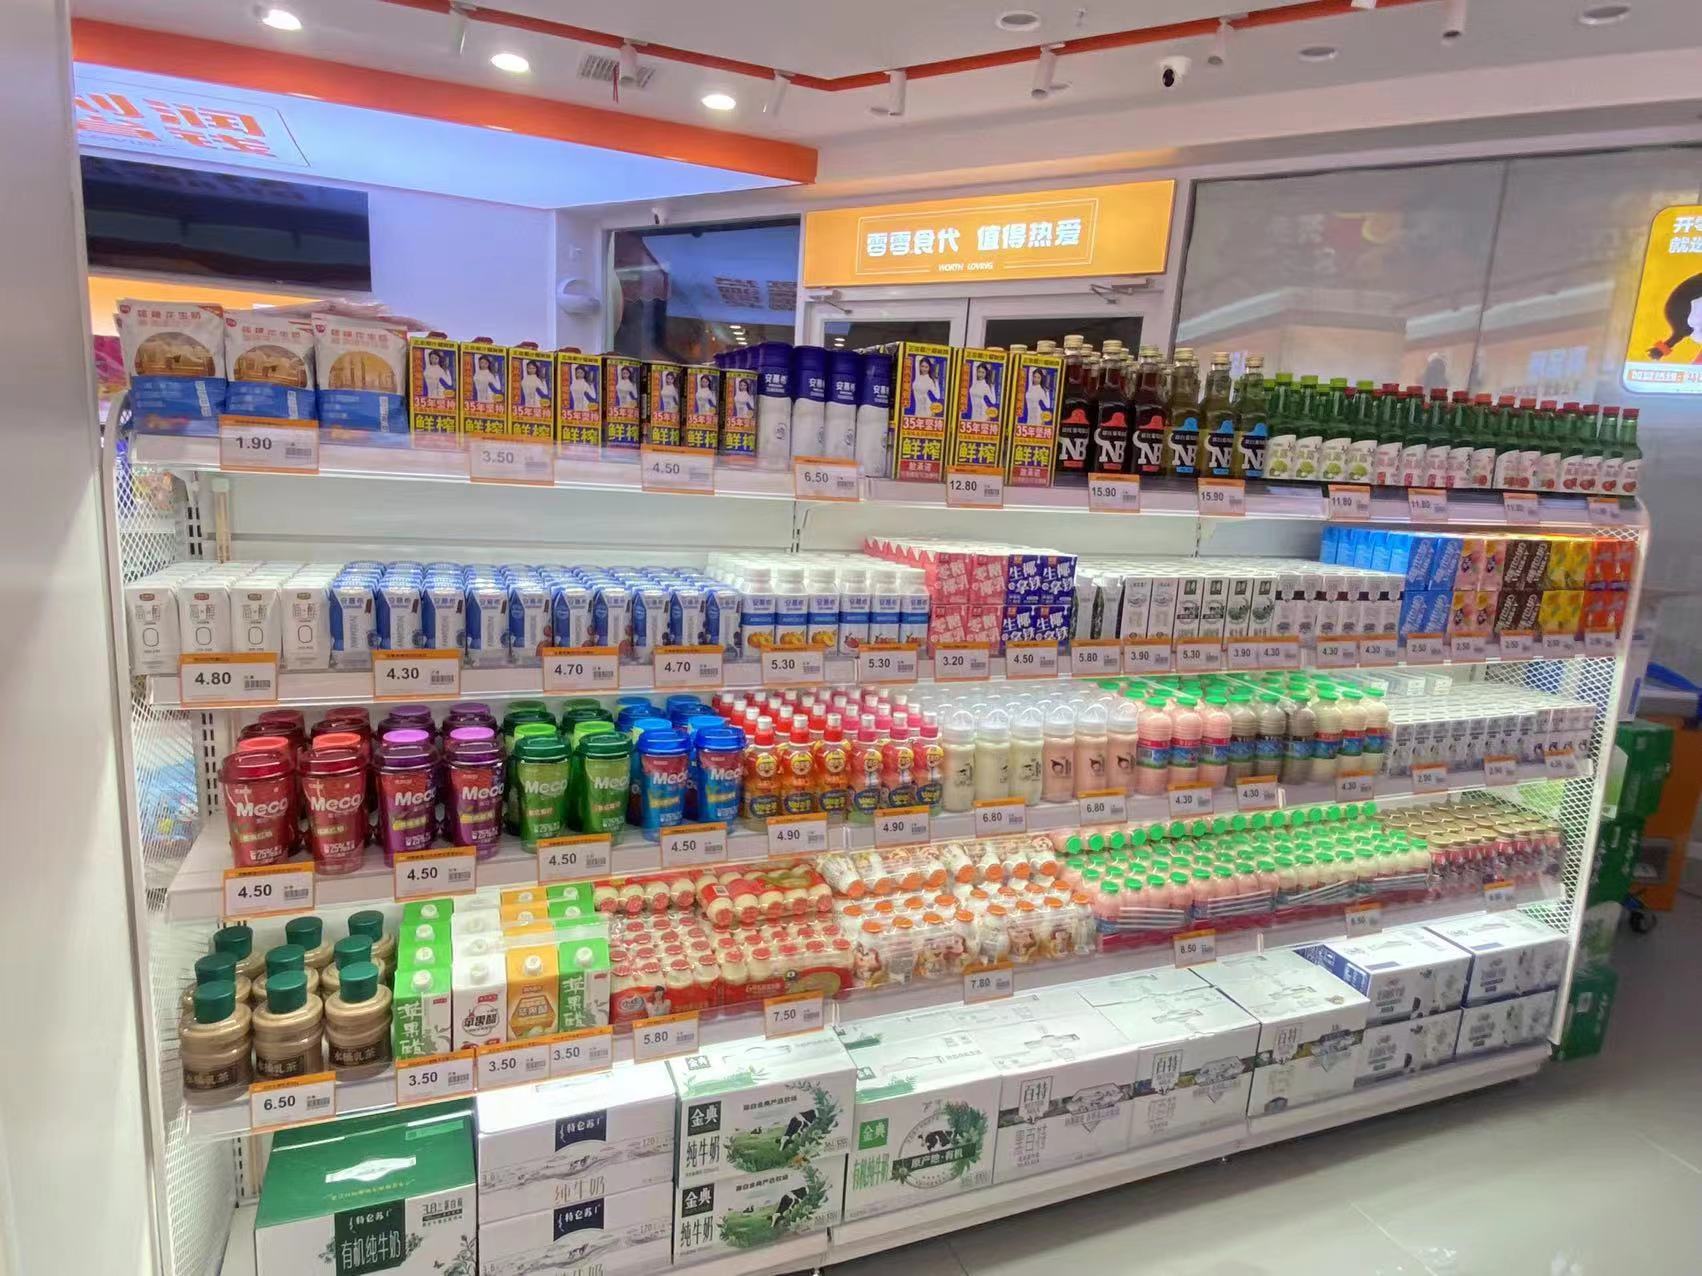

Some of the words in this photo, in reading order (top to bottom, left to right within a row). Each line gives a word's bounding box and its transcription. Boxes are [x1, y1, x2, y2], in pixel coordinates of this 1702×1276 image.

[977, 218, 1081, 251] 值得热爱
[236, 437, 272, 450] 1.90
[902, 439, 941, 460] 鲜榨
[483, 450, 514, 464] 3.50
[959, 442, 996, 463] 鲜榨
[1014, 446, 1050, 466] 鲜榨
[653, 462, 680, 474] 4.50
[805, 472, 829, 483] 6.50
[950, 480, 977, 491] 12.80
[1092, 487, 1117, 497] 15.90
[1201, 492, 1224, 501] 15.90
[1264, 648, 1280, 657] 4.30
[1322, 647, 1338, 656] 4.30
[1412, 643, 1427, 652] 2.50
[1456, 642, 1470, 651] 2.50
[1079, 653, 1098, 662] 5.80
[1131, 651, 1149, 661] 3.90
[1183, 650, 1200, 659] 5.30
[1234, 649, 1250, 657] 3.90
[771, 659, 795, 670] 5.30
[868, 658, 891, 668] 5.30
[943, 656, 964, 666] 3.20
[1014, 655, 1034, 664] 4.50
[554, 664, 584, 676] 4.70
[664, 661, 691, 673] 4.70
[195, 672, 232, 685] 4.80
[387, 668, 420, 680] 4.30
[525, 780, 567, 795] Meco
[1341, 781, 1357, 790] 4.30
[462, 784, 504, 800] Meco
[1243, 789, 1259, 799] 4.30
[311, 792, 362, 810] Meco
[1175, 795, 1192, 804] 4.30
[237, 798, 288, 817] Meco
[1087, 803, 1105, 813] 6.80
[983, 812, 1003, 822] 6.80
[883, 821, 904, 833] 4.90
[777, 830, 800, 841] 4.90
[671, 840, 696, 852] 4.50
[549, 853, 577, 866] 4.50
[407, 867, 438, 880] 4.50
[238, 884, 272, 899] 4.50
[971, 978, 991, 989] 7.80
[774, 1009, 797, 1021] 7.50
[643, 1031, 668, 1044] 5.80
[554, 1046, 580, 1061] 3.50
[489, 1057, 517, 1072] 3.50
[409, 1071, 438, 1086] 3.50
[263, 1095, 296, 1111] 6.50
[689, 1104, 718, 1128] 金典
[567, 1119, 594, 1134] 特仑苏
[863, 1122, 887, 1142] 金典
[686, 1135, 720, 1168] 纯牛奶
[684, 1186, 712, 1209] 金典
[355, 1212, 384, 1226] 特仑苏
[565, 1207, 592, 1222] 特仑苏
[680, 1215, 714, 1248] 纯牛奶
[341, 1229, 401, 1270] 有机纯牛奶
